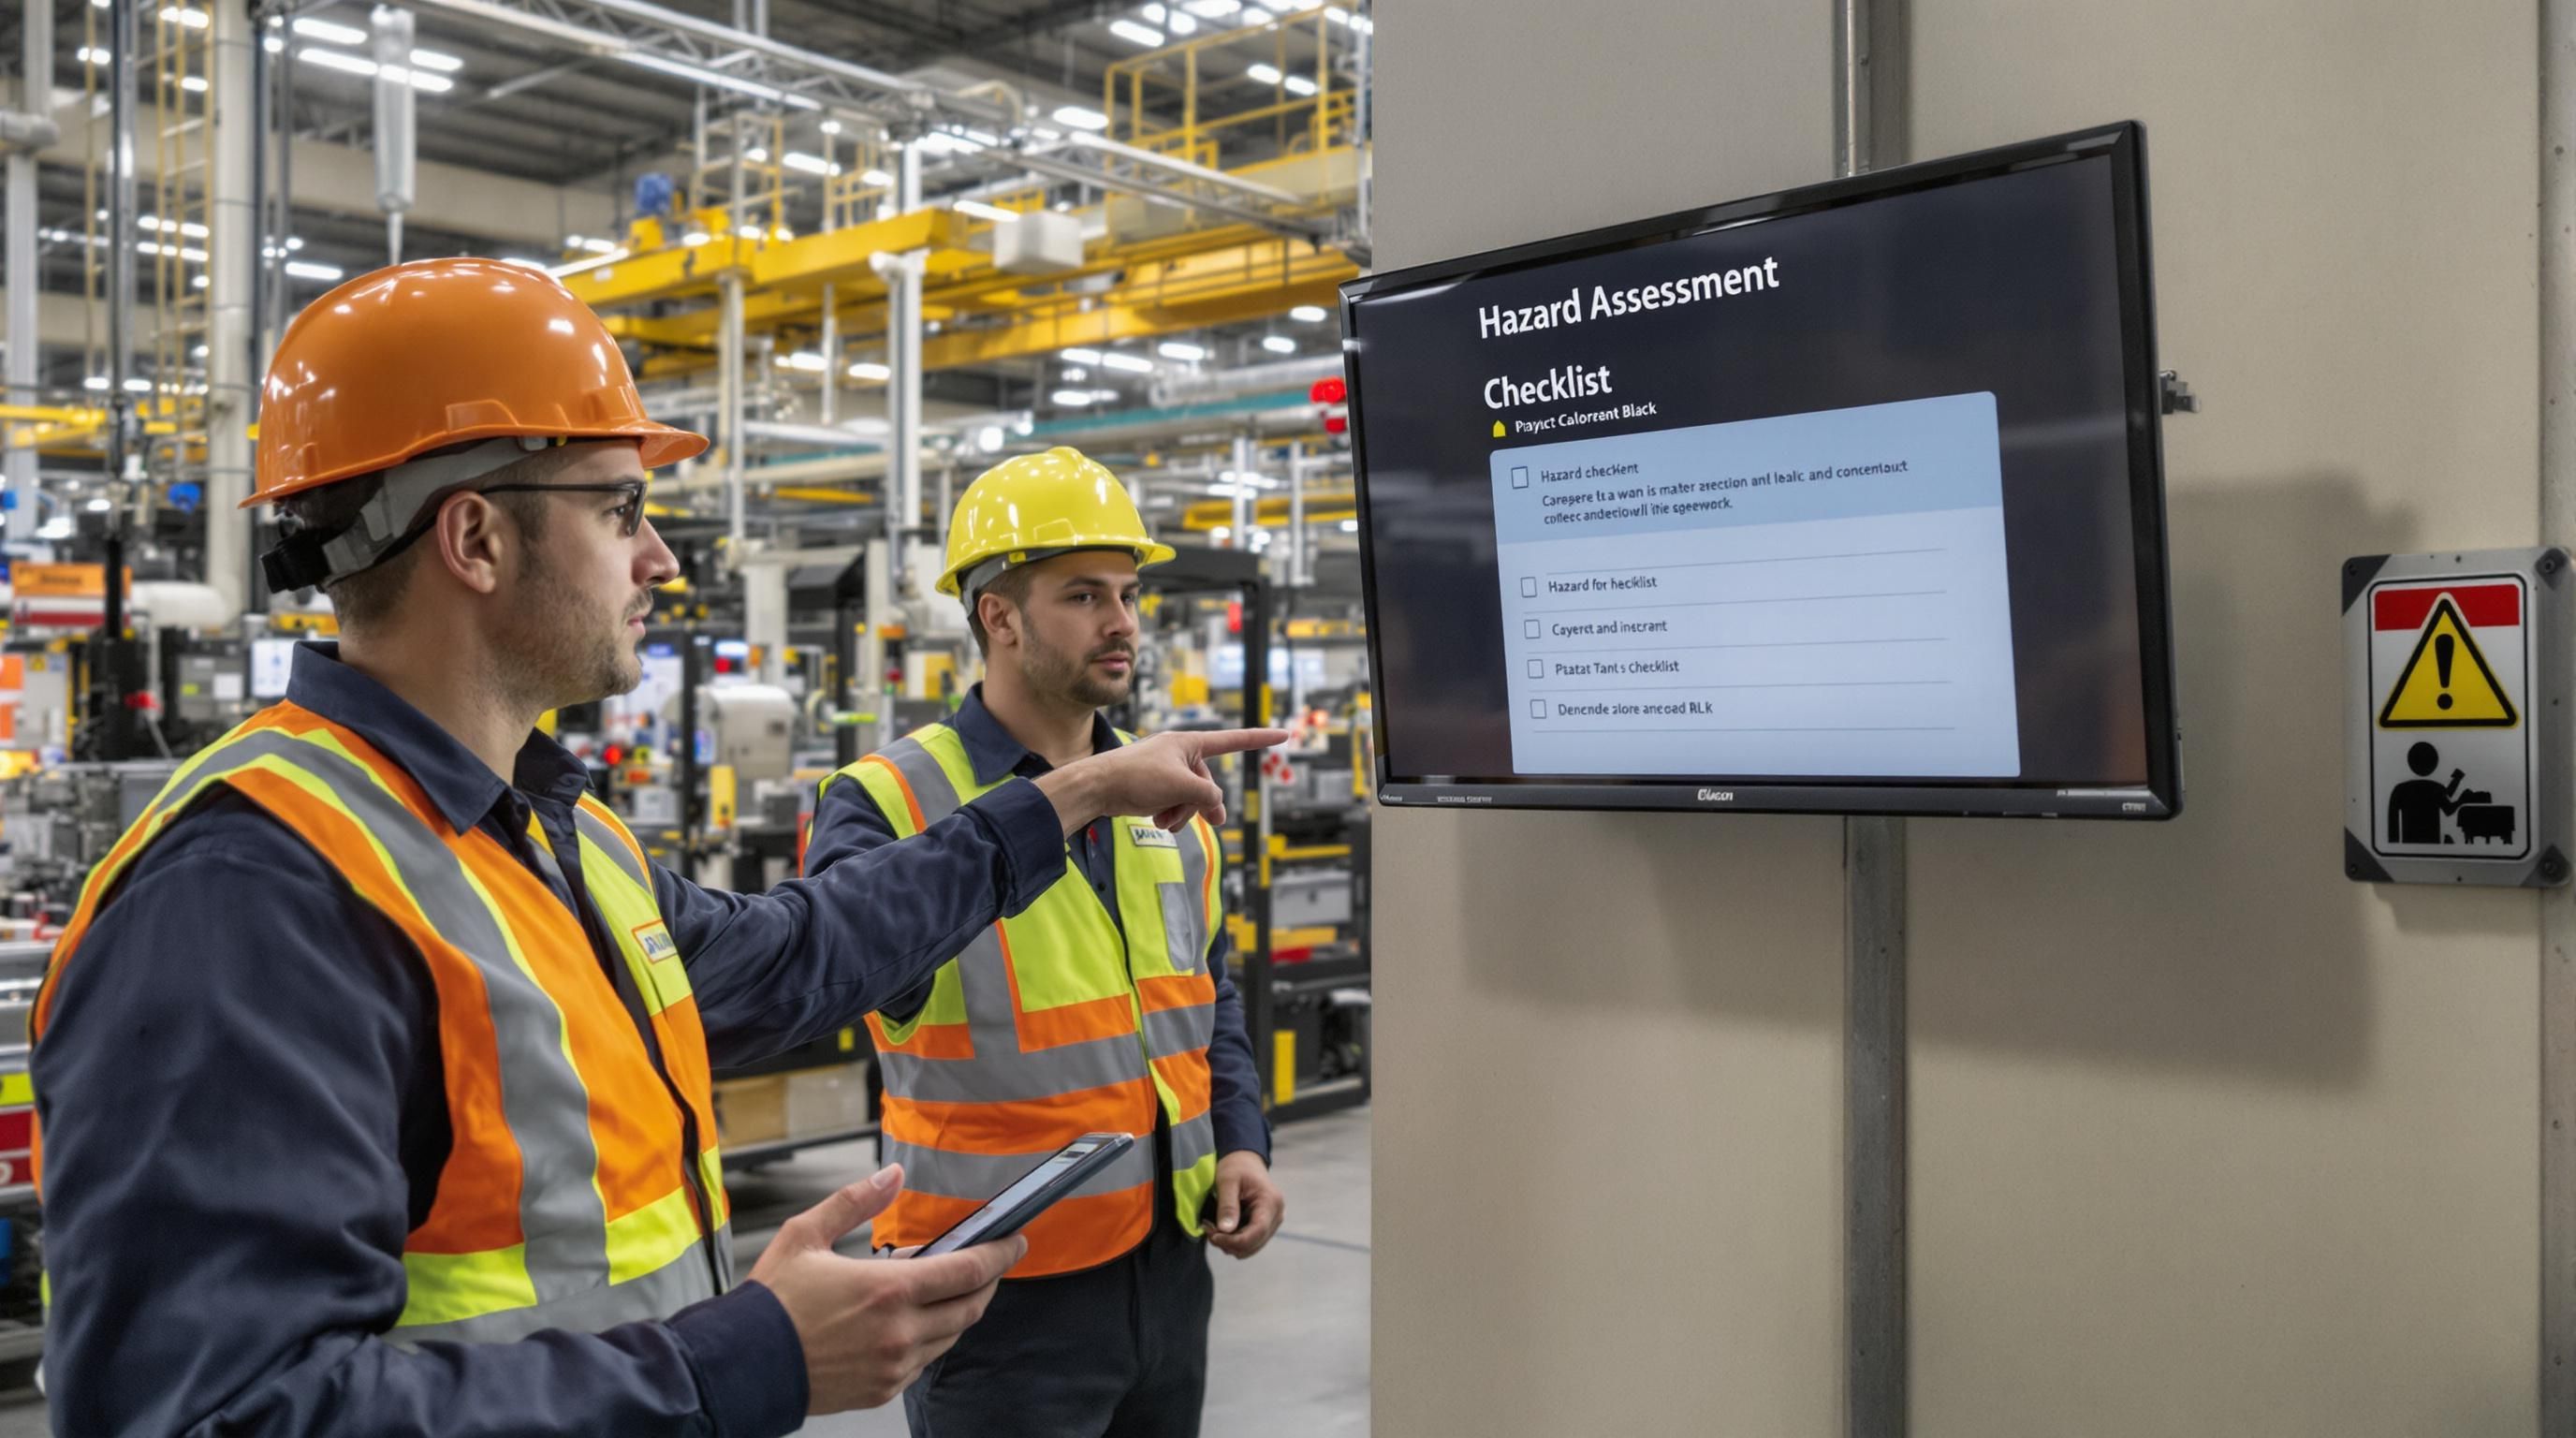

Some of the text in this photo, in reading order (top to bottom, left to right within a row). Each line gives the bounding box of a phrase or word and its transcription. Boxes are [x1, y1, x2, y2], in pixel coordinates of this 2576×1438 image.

[1478, 256, 1779, 339] Hazard Assessment
[1484, 364, 1612, 409] Checklist
[1622, 401, 1658, 418] Black
[1541, 465, 1582, 483] Hazard
[1647, 484, 1657, 497] is
[1808, 466, 1833, 481] and
[1548, 578, 1589, 594] Hazard
[1592, 578, 1607, 592] for
[1596, 620, 1617, 635] and
